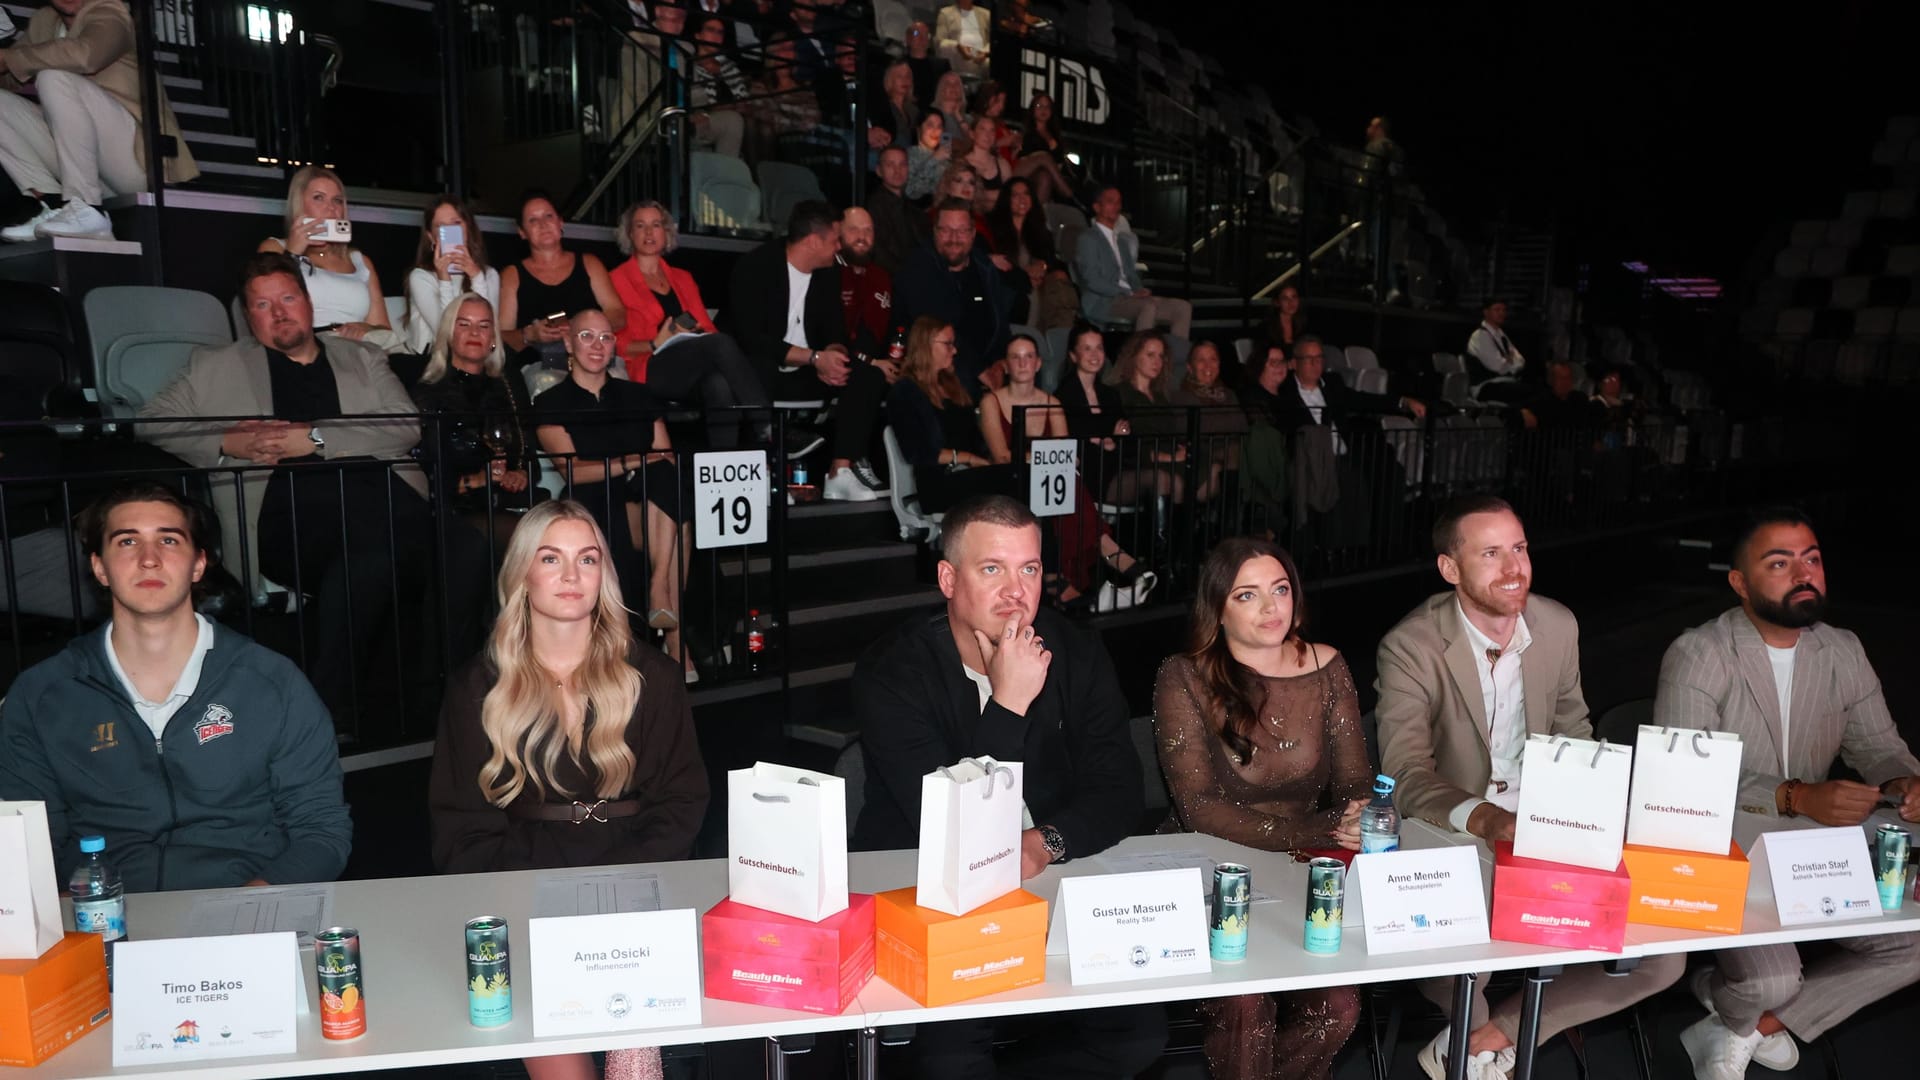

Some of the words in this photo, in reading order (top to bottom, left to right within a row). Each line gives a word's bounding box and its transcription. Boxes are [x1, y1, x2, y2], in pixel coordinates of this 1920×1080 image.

[1033, 449, 1073, 466] BLOCK
[699, 463, 761, 484] BLOCK
[1041, 474, 1066, 506] 19
[711, 496, 752, 536] 19
[1791, 862, 1827, 873] Christian
[1828, 859, 1849, 869] Stapf
[1387, 873, 1412, 884] Anne
[1413, 870, 1451, 881] Menden
[1814, 871, 1827, 879] Team
[1092, 907, 1130, 918] Gustav
[1133, 901, 1178, 915] Masurek
[1116, 917, 1140, 925] Reality
[1141, 915, 1156, 924] Star
[1520, 912, 1561, 926] Beauty
[1560, 917, 1591, 928] Drink
[574, 951, 607, 962] Anna
[611, 946, 651, 960] Osicki
[732, 969, 772, 984] Beauty
[771, 973, 804, 986] Drink
[162, 983, 196, 995] Timo
[200, 979, 244, 992] Bakos
[176, 995, 192, 1004] ICE
[195, 993, 230, 1003] TIGERS
